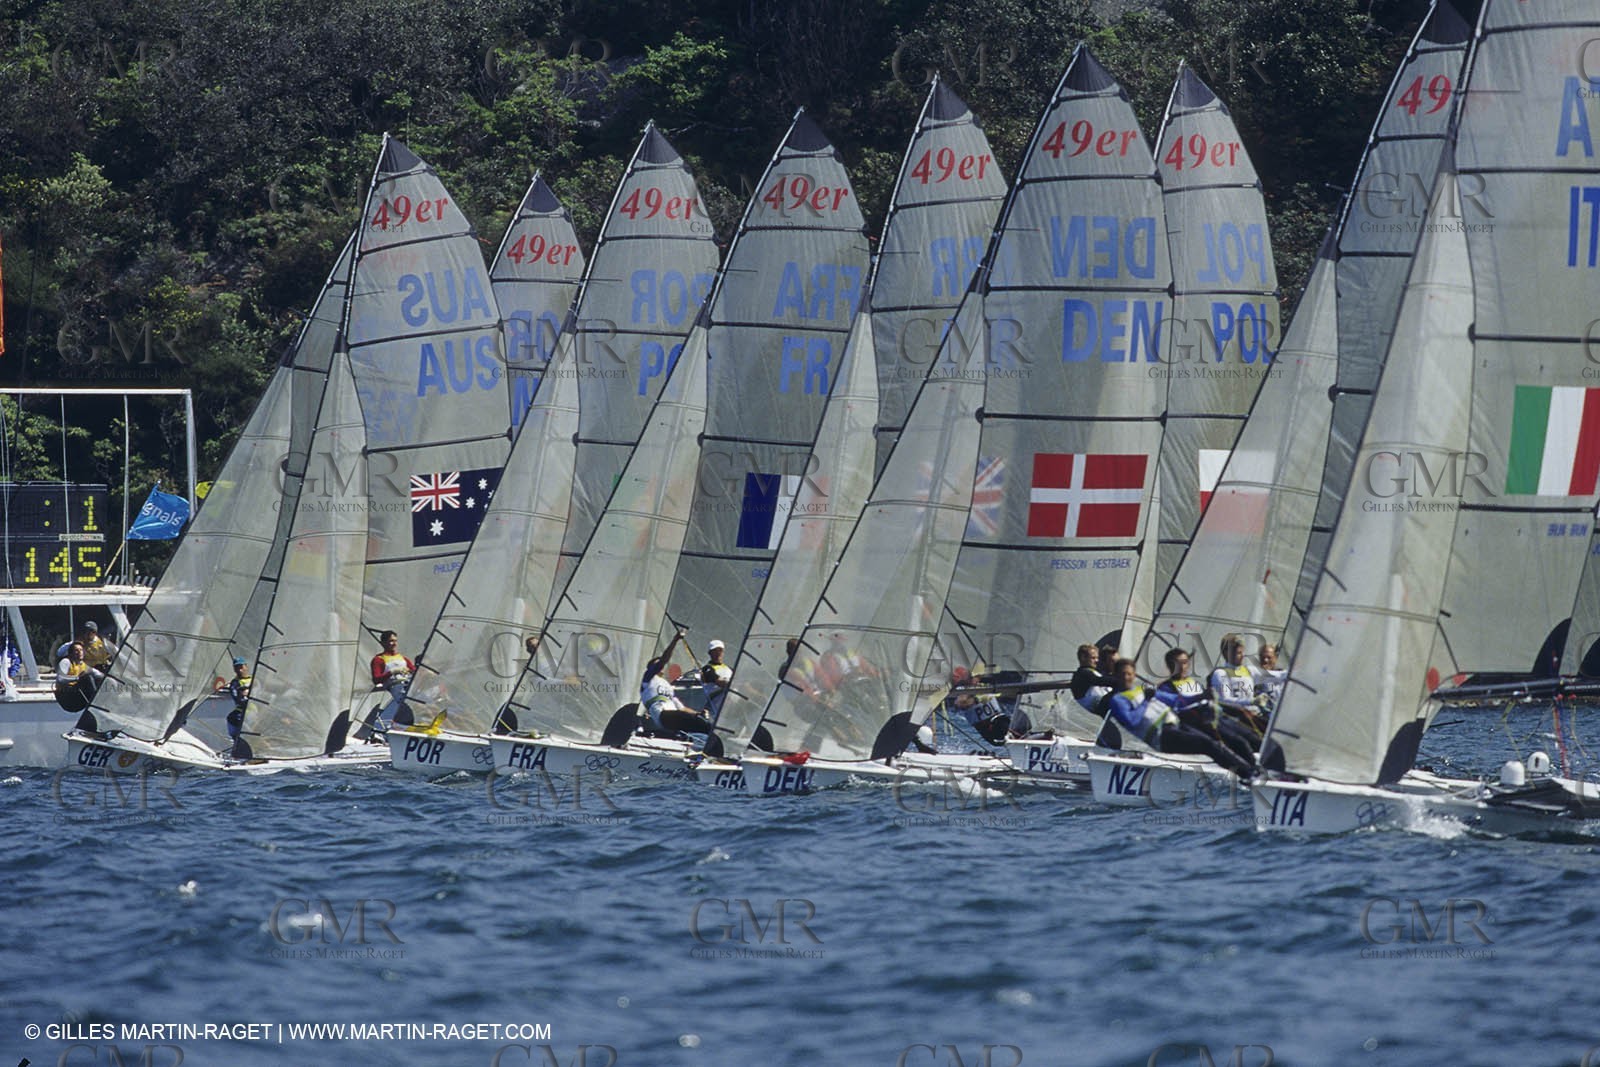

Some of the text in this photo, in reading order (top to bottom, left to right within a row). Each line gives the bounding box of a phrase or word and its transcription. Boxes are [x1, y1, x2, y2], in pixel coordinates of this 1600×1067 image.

[1397, 75, 1452, 116] 49
[1042, 120, 1137, 159] 49er
[1164, 134, 1240, 171] 49er
[911, 147, 991, 184] 49er
[620, 187, 698, 220] 49er
[763, 176, 848, 211] 49er
[371, 195, 448, 230] 49er
[1568, 186, 1600, 268] IT
[507, 234, 576, 266] 49er
[1062, 298, 1163, 363] DEN
[417, 335, 499, 397] AUS
[780, 336, 832, 395] FR
[83, 495, 97, 531] 1
[25, 547, 101, 582] 145
[78, 744, 114, 768] GER
[403, 736, 445, 765] POR
[508, 743, 548, 771] FRA
[763, 765, 815, 793] DEN
[1271, 788, 1309, 827] ITA
